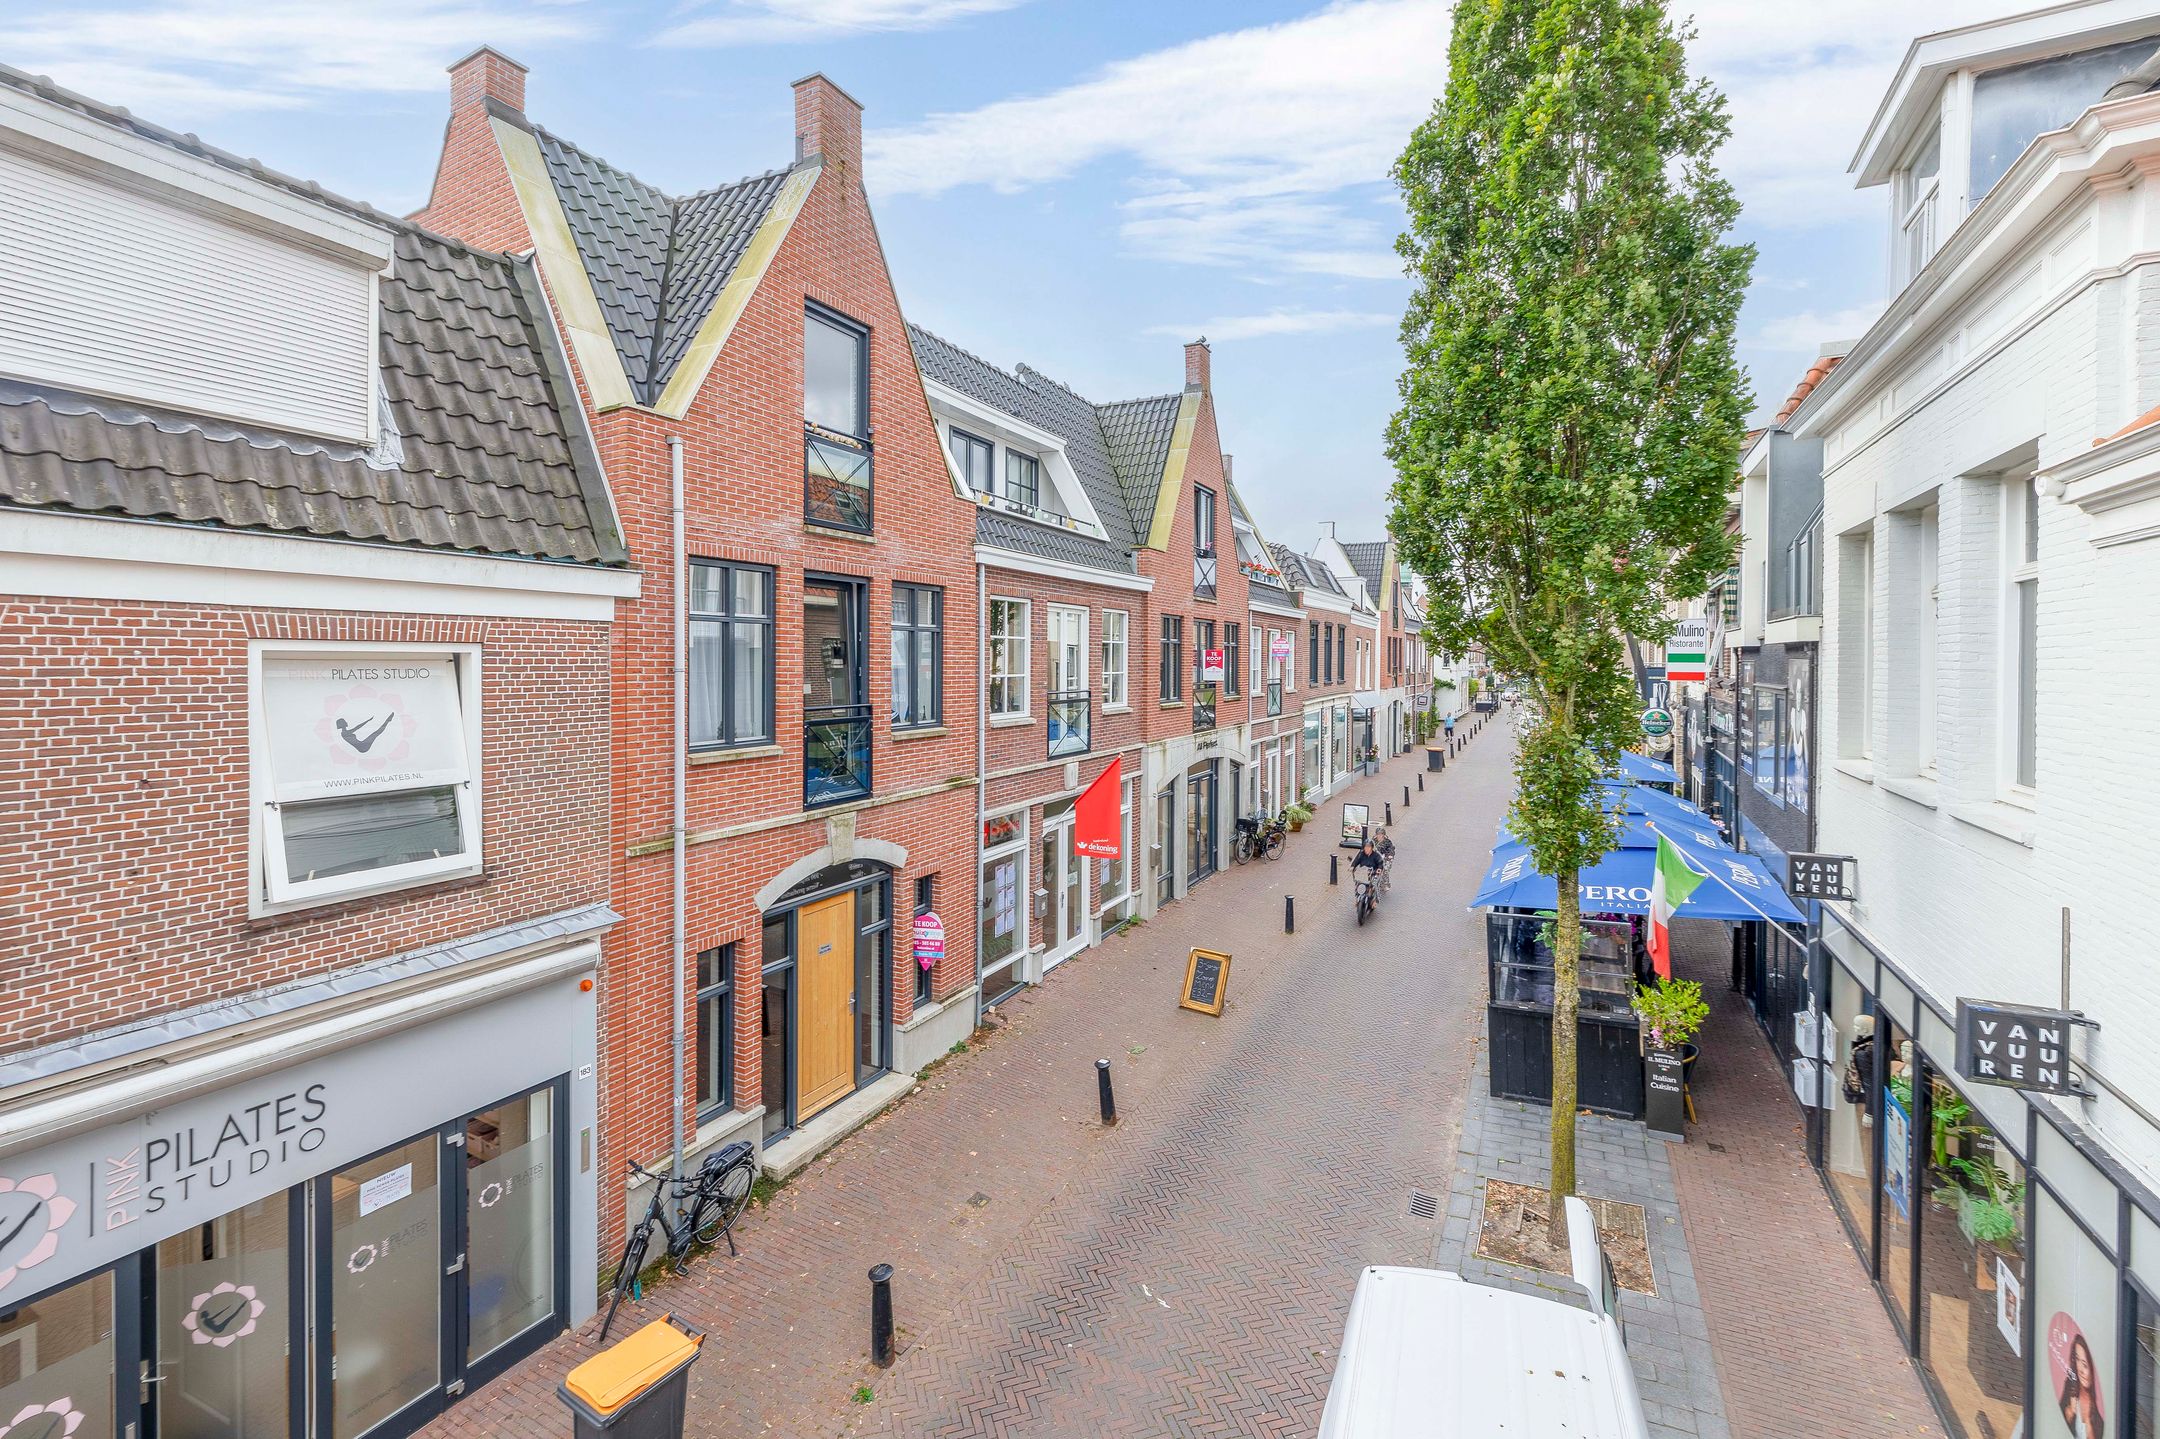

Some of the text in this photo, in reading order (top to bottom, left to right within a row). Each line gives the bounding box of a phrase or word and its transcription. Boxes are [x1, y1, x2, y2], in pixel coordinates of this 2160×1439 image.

[1669, 639, 1704, 648] Ristorante
[331, 668, 379, 680] PILATES
[383, 667, 430, 680] STUDIO
[324, 773, 424, 789] WWW.PINKPILATES.NL
[1795, 861, 1838, 873] VAN
[1795, 873, 1838, 884] VUU
[1795, 883, 1838, 895] REN
[1978, 1020, 2060, 1045] VAN
[1978, 1039, 2059, 1064] VUU
[580, 1067, 591, 1076] 183
[1979, 1059, 2059, 1085] REN
[1652, 1074, 1677, 1083] Italian
[1650, 1081, 1680, 1092] Cuisine
[146, 1083, 326, 1183] PILATES
[146, 1127, 326, 1214] STUDIO
[106, 1147, 140, 1231] PINK
